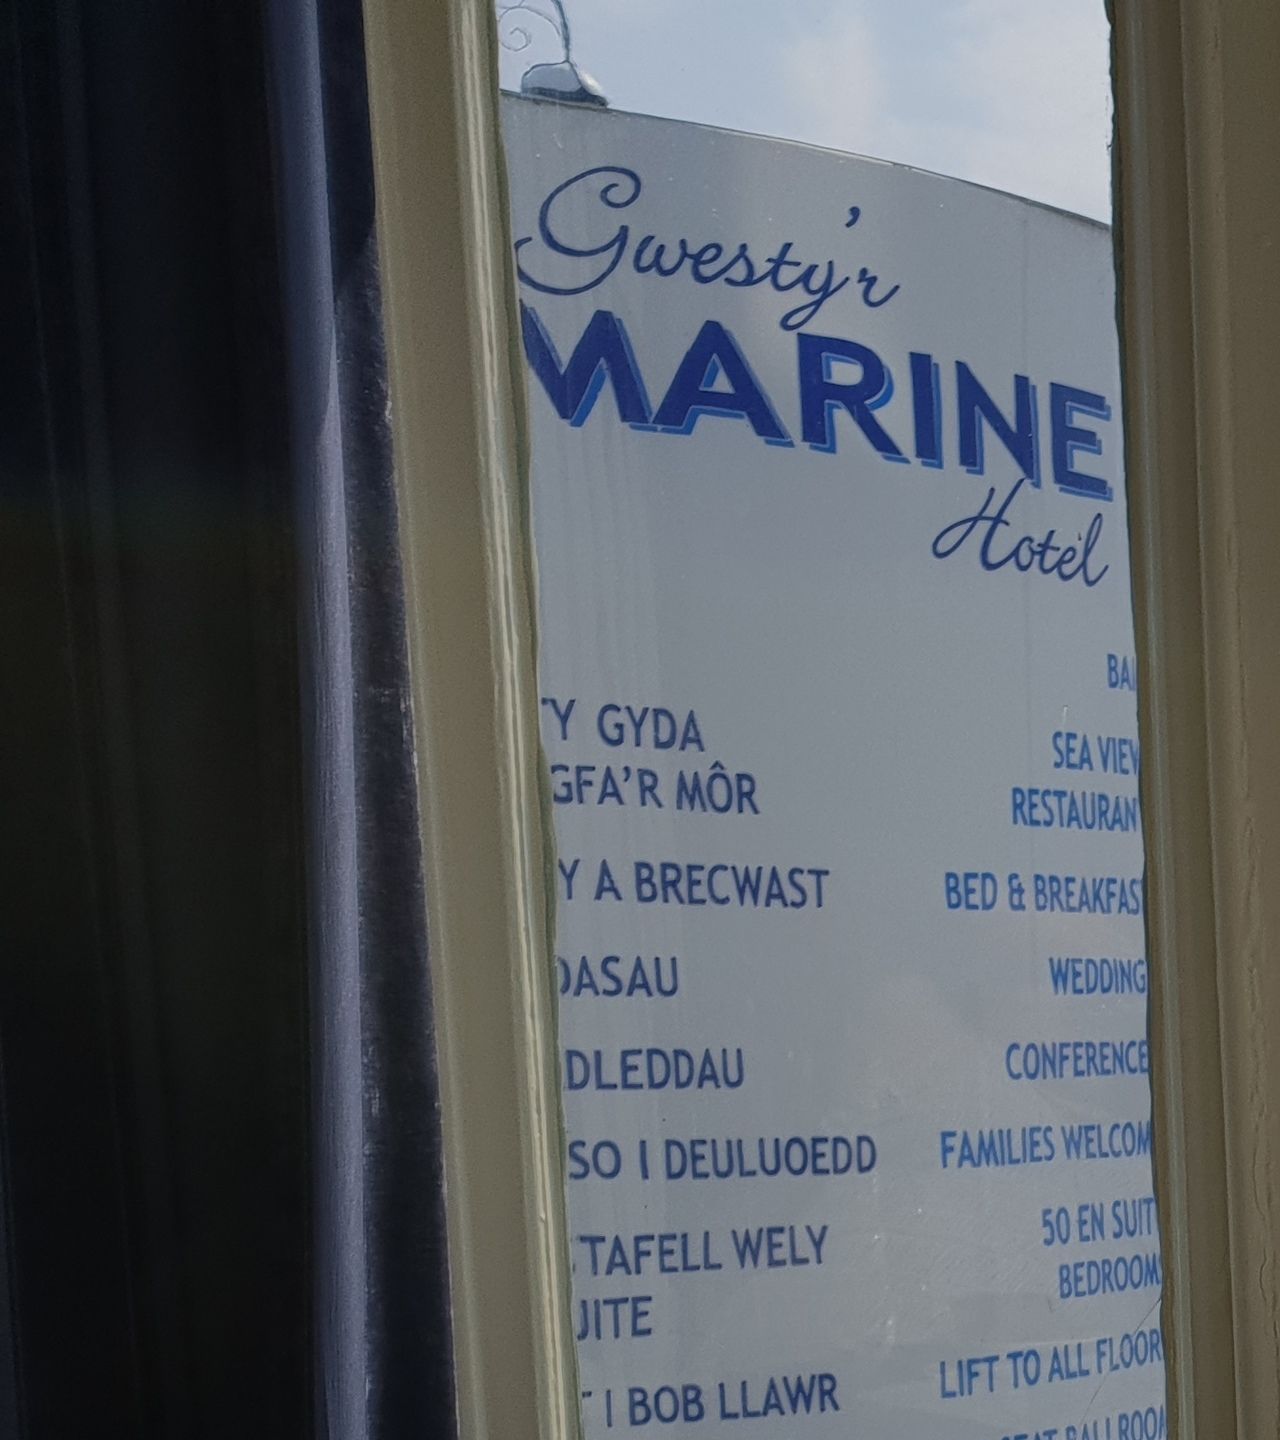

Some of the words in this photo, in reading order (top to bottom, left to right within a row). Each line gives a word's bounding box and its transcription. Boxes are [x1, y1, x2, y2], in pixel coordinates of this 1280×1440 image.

[515, 166, 899, 332] Gwesty'r
[519, 298, 1112, 501] MARINE
[931, 479, 1109, 587] Hotel
[1107, 654, 1136, 691] BA
[541, 697, 576, 740] Y
[597, 704, 704, 752] GYDA
[1052, 731, 1093, 772] SEA
[676, 760, 760, 815] MÔR
[1011, 787, 1136, 832] RESTAURAN
[594, 858, 623, 901] A
[633, 861, 830, 909] BRECWAST
[944, 871, 997, 911] BED
[1008, 873, 1027, 911] &
[1034, 872, 1143, 915] BREAKFAS
[1049, 957, 1146, 995] WEDDING
[565, 1047, 744, 1090] DLEDDAU
[1005, 1040, 1149, 1080] CONFERENCE
[568, 1139, 621, 1180] SO
[639, 1139, 650, 1180] I
[665, 1136, 877, 1180] DEULUOEDD
[940, 1125, 1055, 1169] FAMILIES
[1061, 1121, 1150, 1160] WELCOM
[1041, 1207, 1071, 1246] 50
[1077, 1203, 1105, 1242] EN
[1111, 1197, 1155, 1239] SUIT
[572, 1230, 722, 1276] TAFELL
[731, 1225, 828, 1268] WELY
[1059, 1253, 1160, 1299] BEDROOM
[940, 1355, 999, 1399] LIFT
[1007, 1350, 1041, 1389] TO
[1048, 1342, 1089, 1383] ALL
[1096, 1328, 1161, 1374] FLOOR
[606, 1389, 612, 1428] I
[628, 1384, 705, 1427] BOB
[718, 1372, 840, 1421] LLAWR
